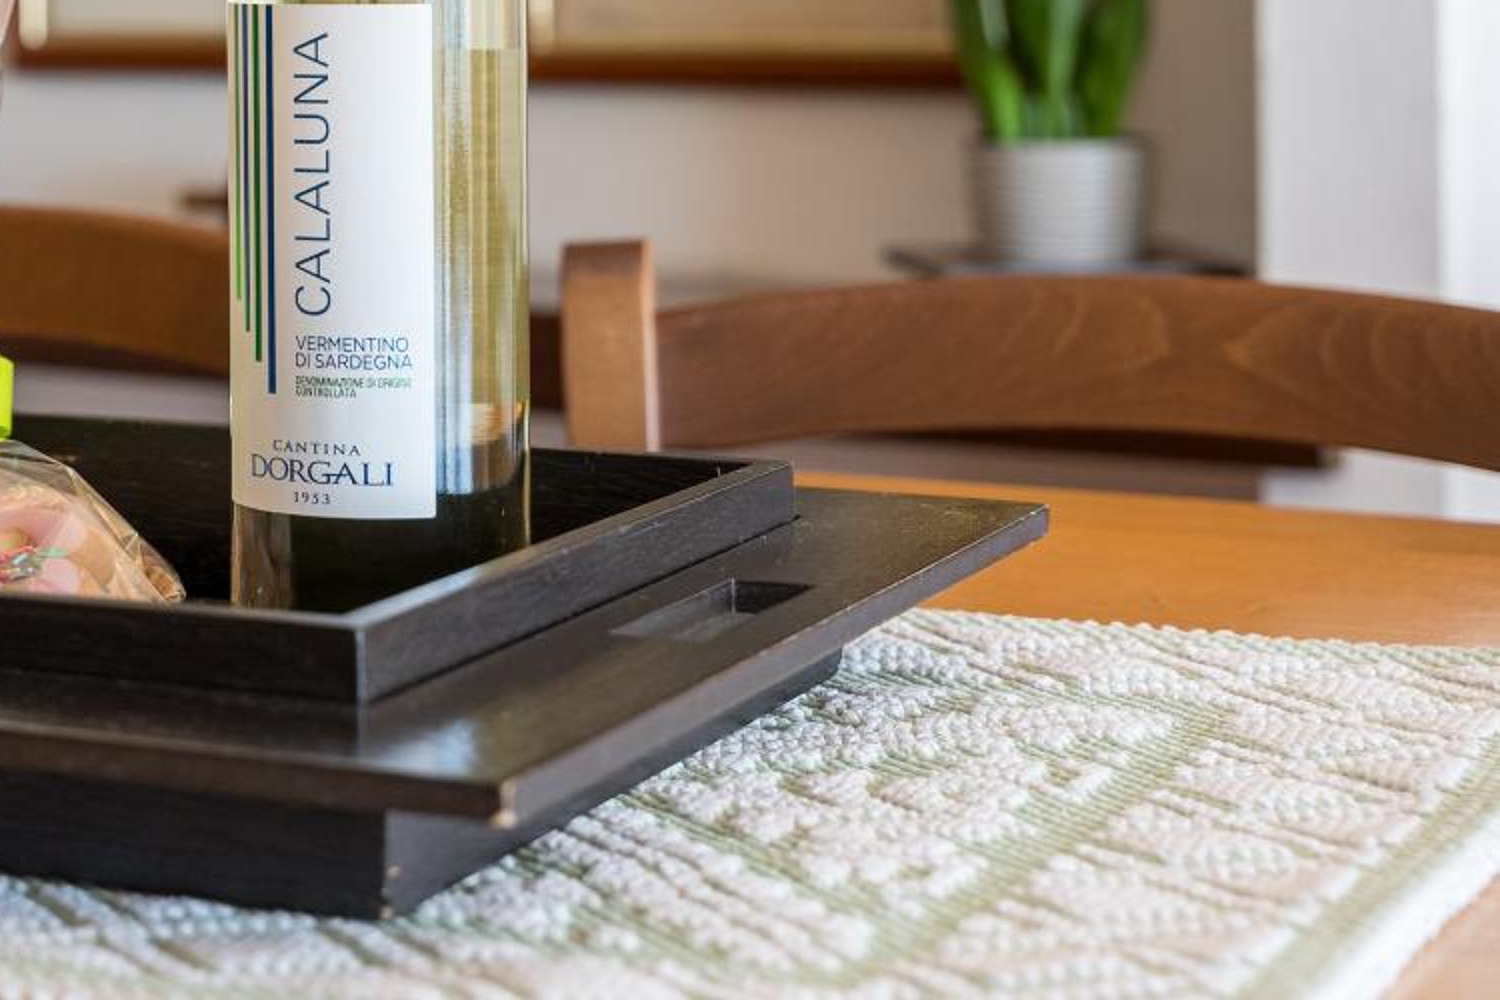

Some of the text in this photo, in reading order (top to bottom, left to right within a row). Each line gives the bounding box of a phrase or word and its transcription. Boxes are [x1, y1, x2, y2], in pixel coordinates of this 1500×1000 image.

[293, 32, 332, 317] CALALUNA
[295, 335, 409, 353] VERMENTINO
[295, 353, 413, 371] DI SARDEGNA
[273, 439, 361, 457] CANTINA
[251, 454, 395, 487] DORGALI
[293, 491, 331, 505] 1953
